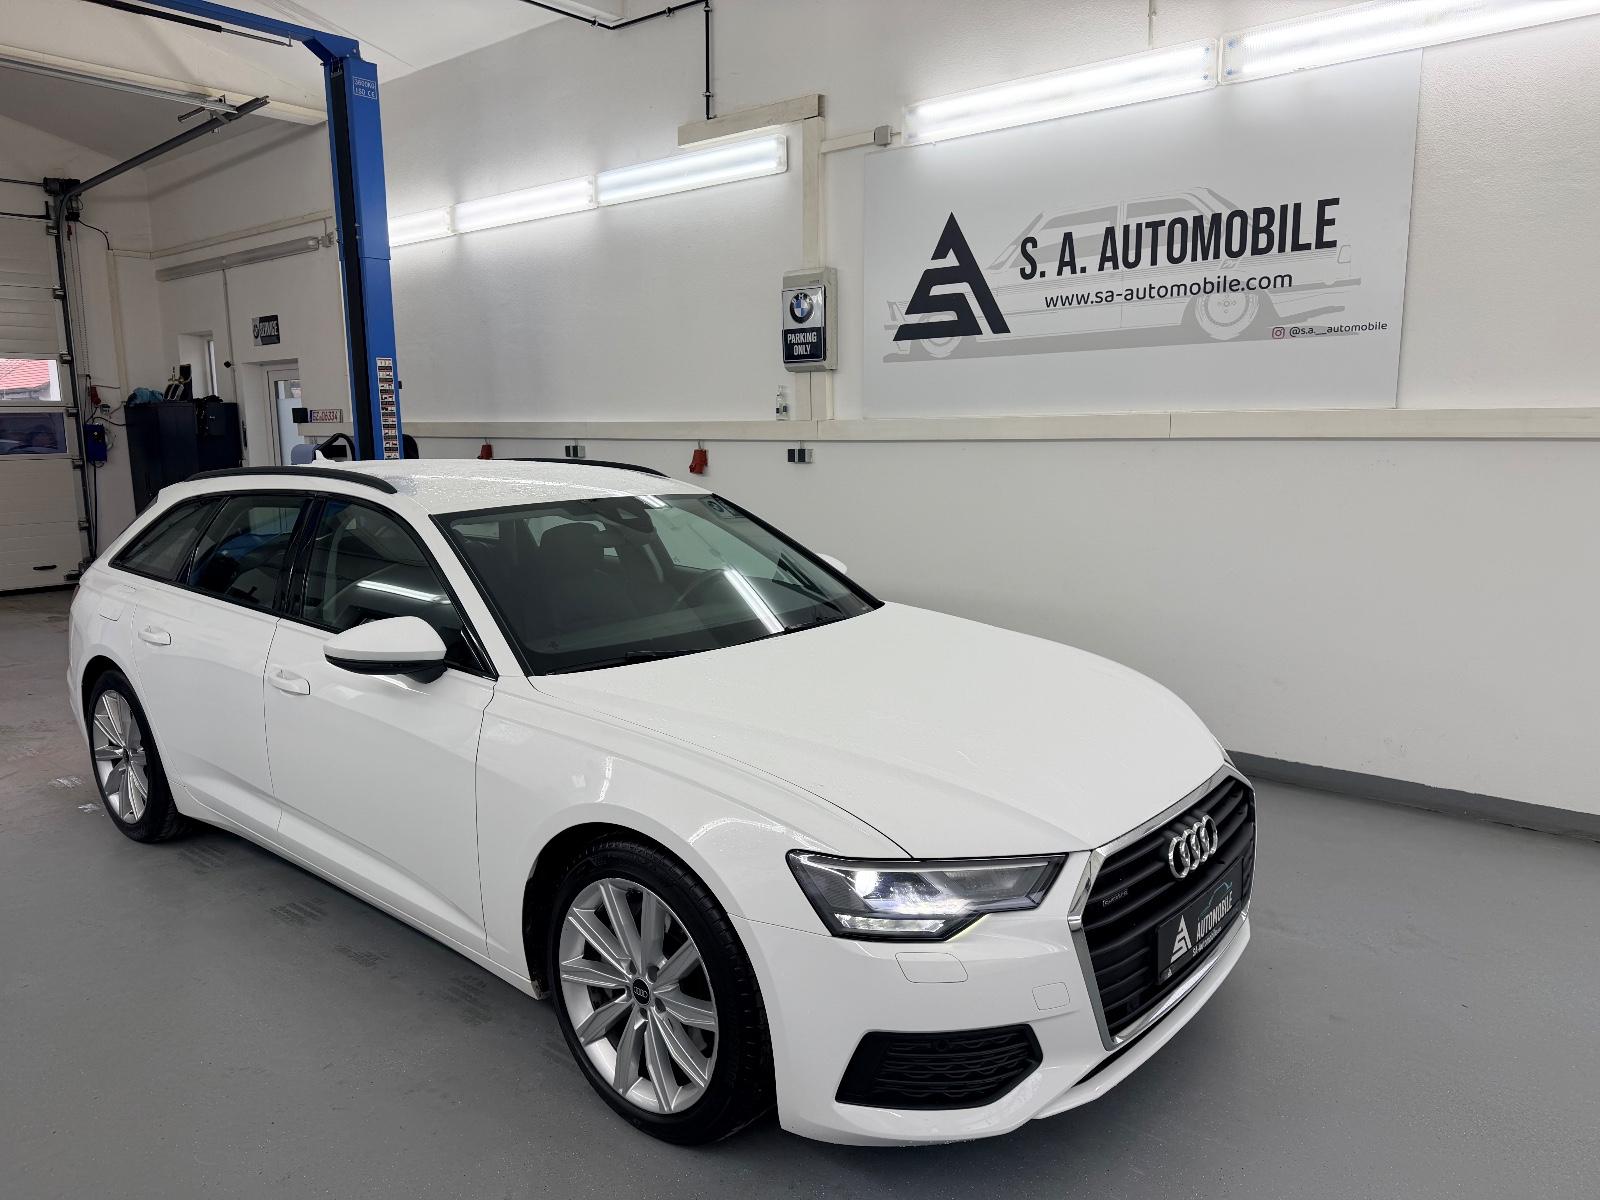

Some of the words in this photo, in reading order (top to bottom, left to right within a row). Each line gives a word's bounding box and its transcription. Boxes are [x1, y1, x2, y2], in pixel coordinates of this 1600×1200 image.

[1019, 236, 1046, 281] S.
[1056, 231, 1087, 277] A.
[1099, 197, 1340, 272] AUTOMOBILE
[1044, 272, 1293, 309] www.sa-automobile.com
[787, 331, 817, 344] PARKING
[793, 345, 811, 356] ONLY
[1196, 890, 1233, 943] AUTOMOBILE
